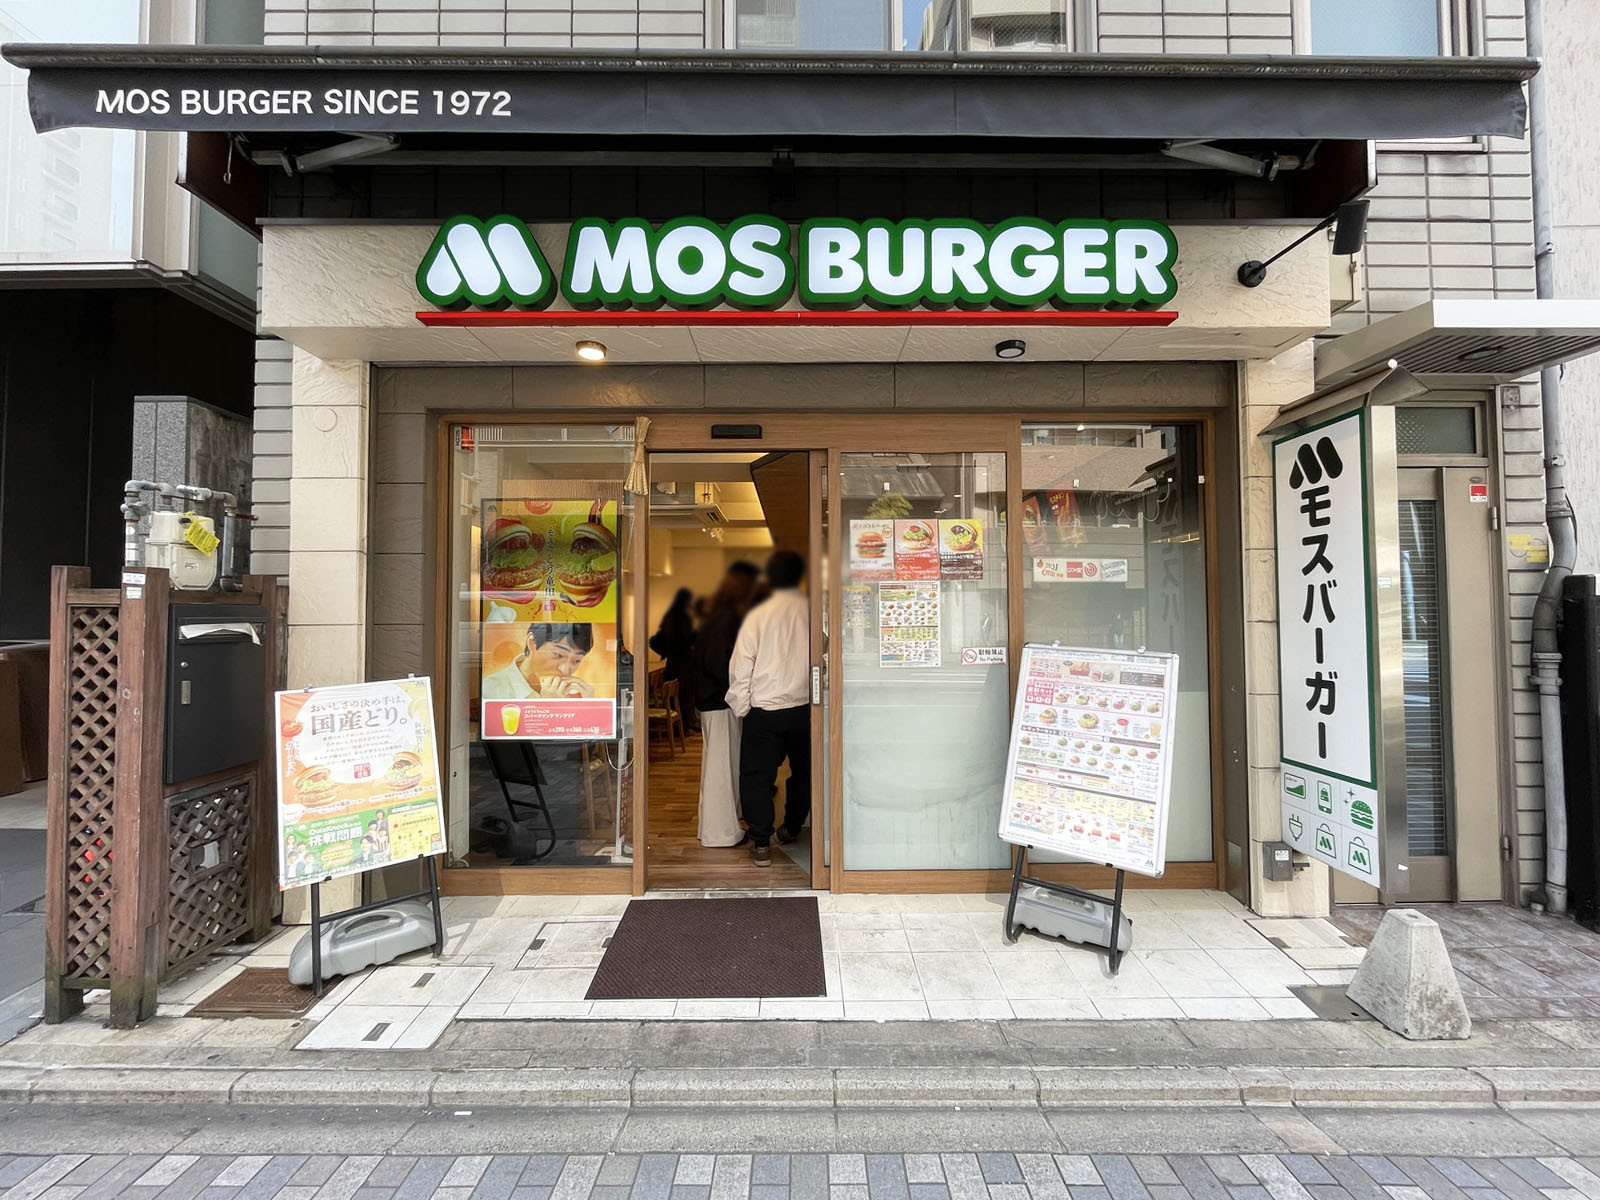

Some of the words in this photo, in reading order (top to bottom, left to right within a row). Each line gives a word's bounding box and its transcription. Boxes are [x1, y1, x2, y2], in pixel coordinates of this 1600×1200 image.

[95, 88, 171, 115] MOS
[180, 88, 313, 116] BURGER
[323, 89, 419, 116] SINCE
[431, 89, 512, 117] 1972
[570, 223, 786, 297] MOS
[808, 225, 1169, 297] BURGER
[1299, 484, 1339, 760] モスバーガー
[311, 706, 408, 736] 国産どり。
